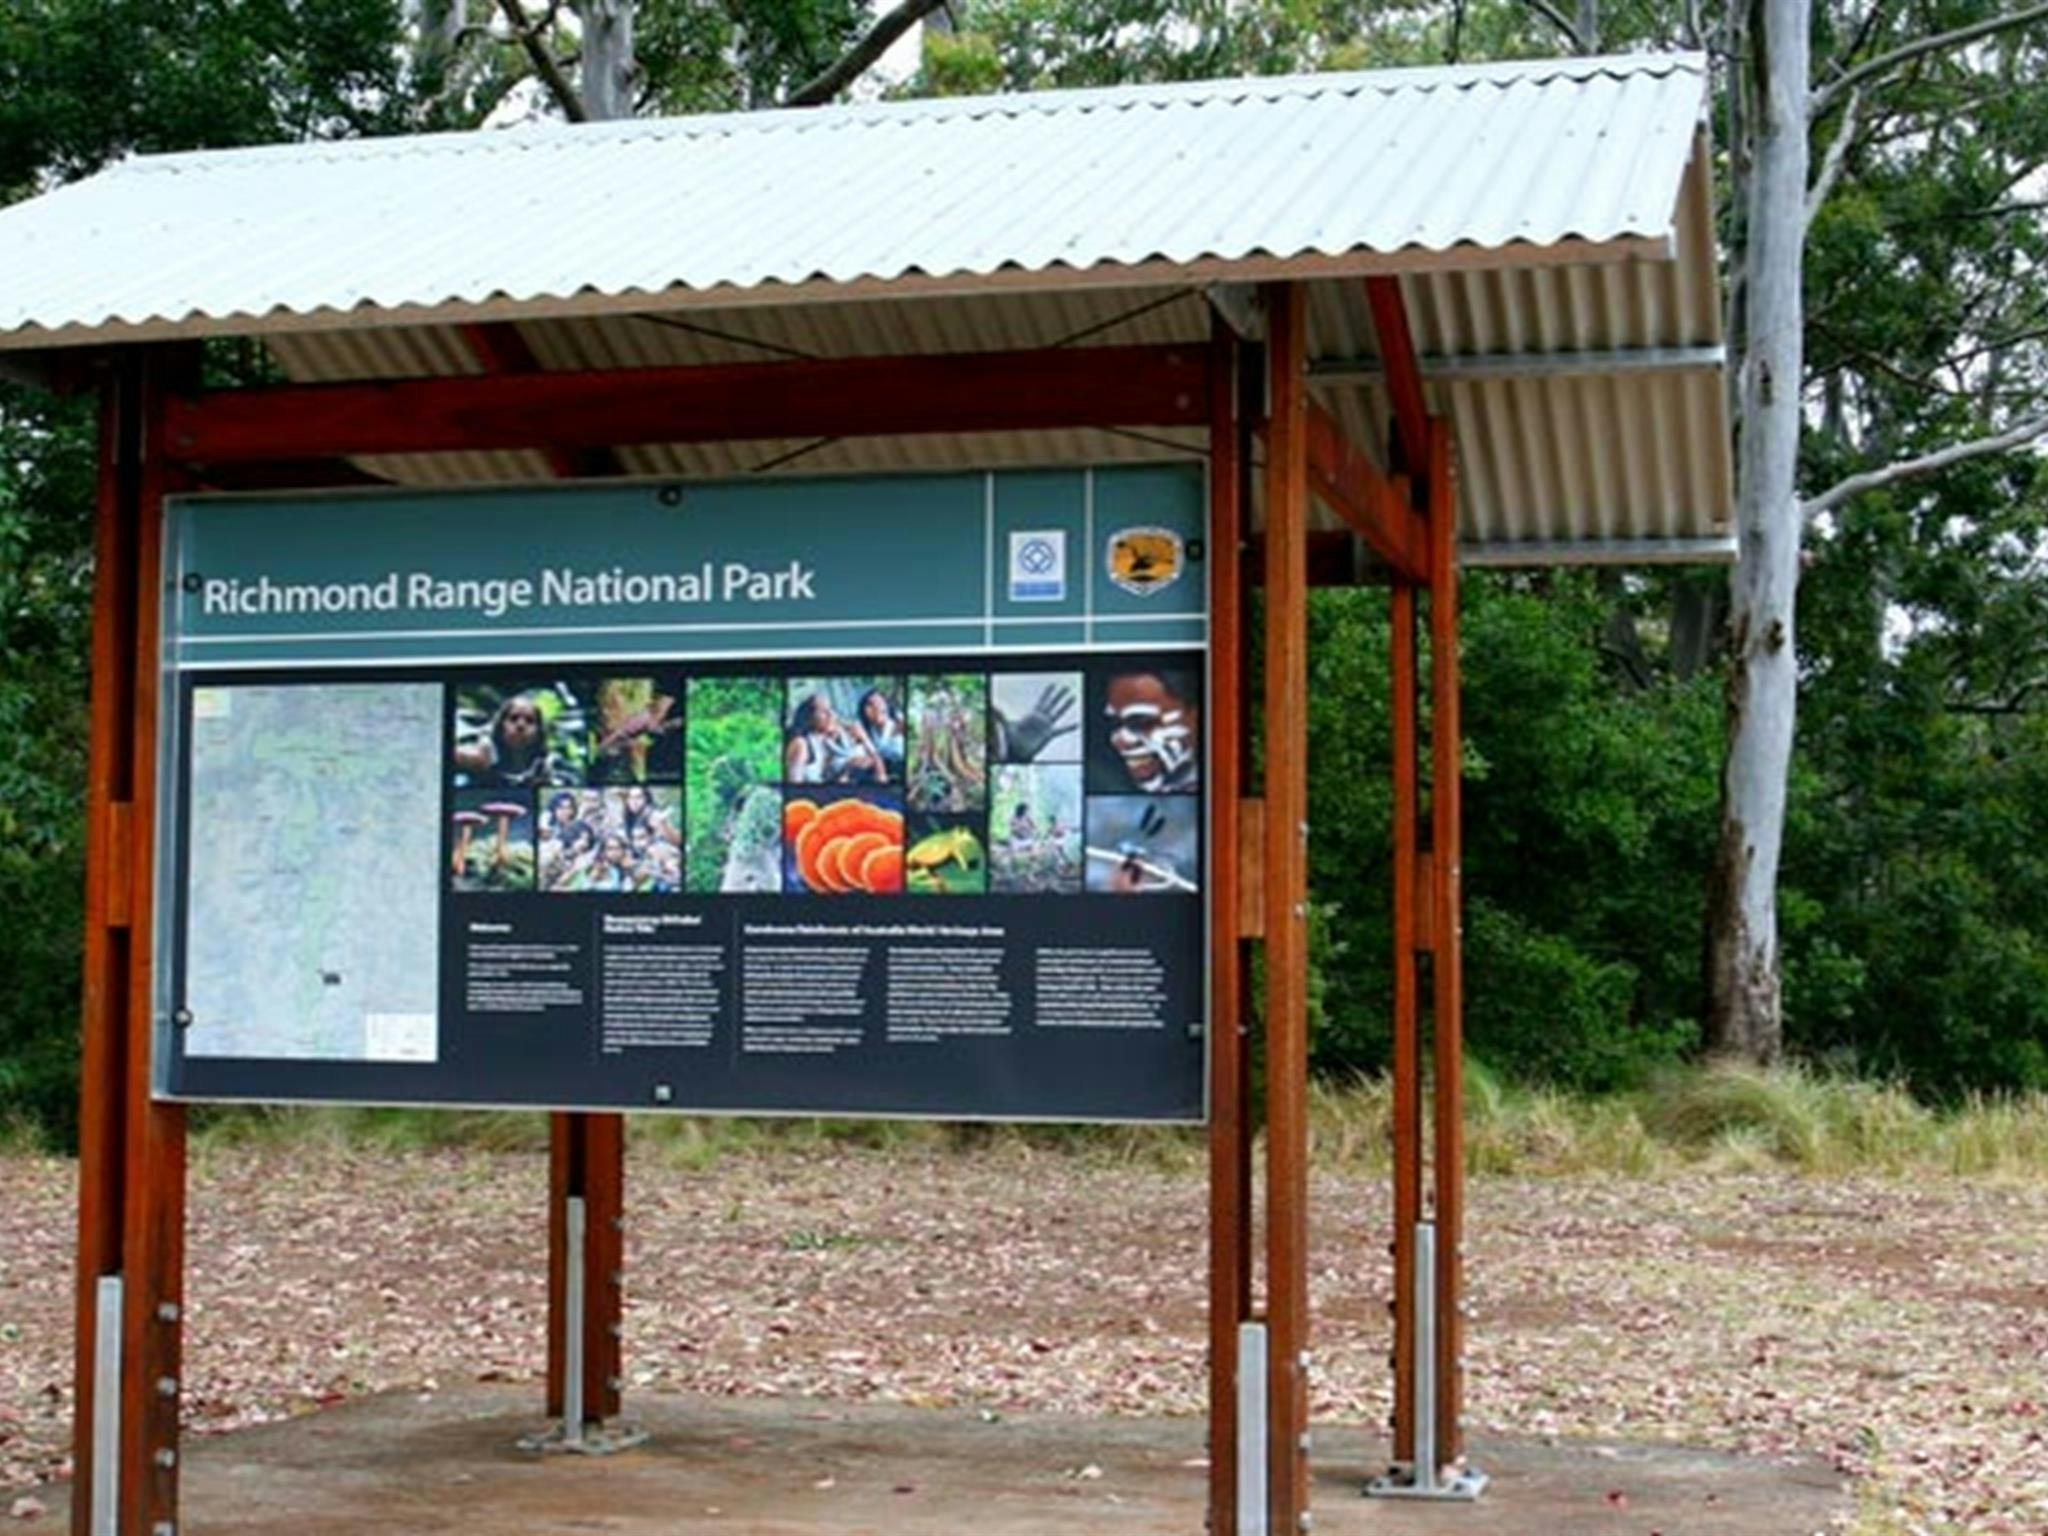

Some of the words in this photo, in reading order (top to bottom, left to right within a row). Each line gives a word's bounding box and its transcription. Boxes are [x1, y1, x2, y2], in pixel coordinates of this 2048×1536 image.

[203, 573, 399, 614] Richmond
[408, 572, 533, 617] Range
[541, 563, 713, 606] National
[722, 560, 816, 602] Park
